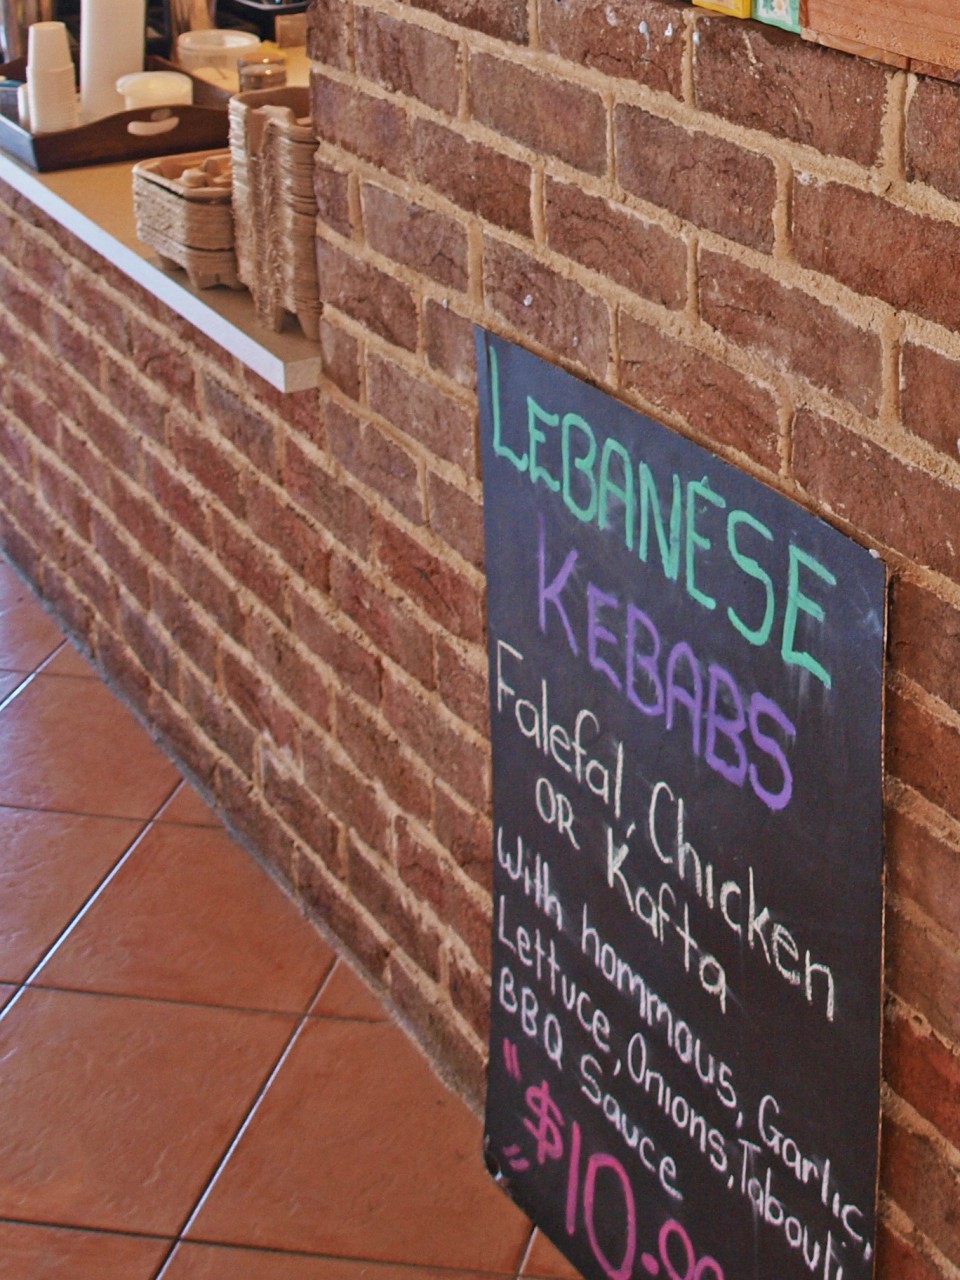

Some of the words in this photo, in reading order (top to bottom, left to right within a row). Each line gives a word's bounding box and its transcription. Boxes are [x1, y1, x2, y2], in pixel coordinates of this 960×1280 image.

[489, 344, 837, 690] LEBANESE
[537, 512, 796, 811] KEBABS
[535, 777, 580, 851] OR
[649, 781, 835, 1022] Chicken
[499, 966, 564, 1071] BBQ
[579, 1054, 684, 1201] Sauce
